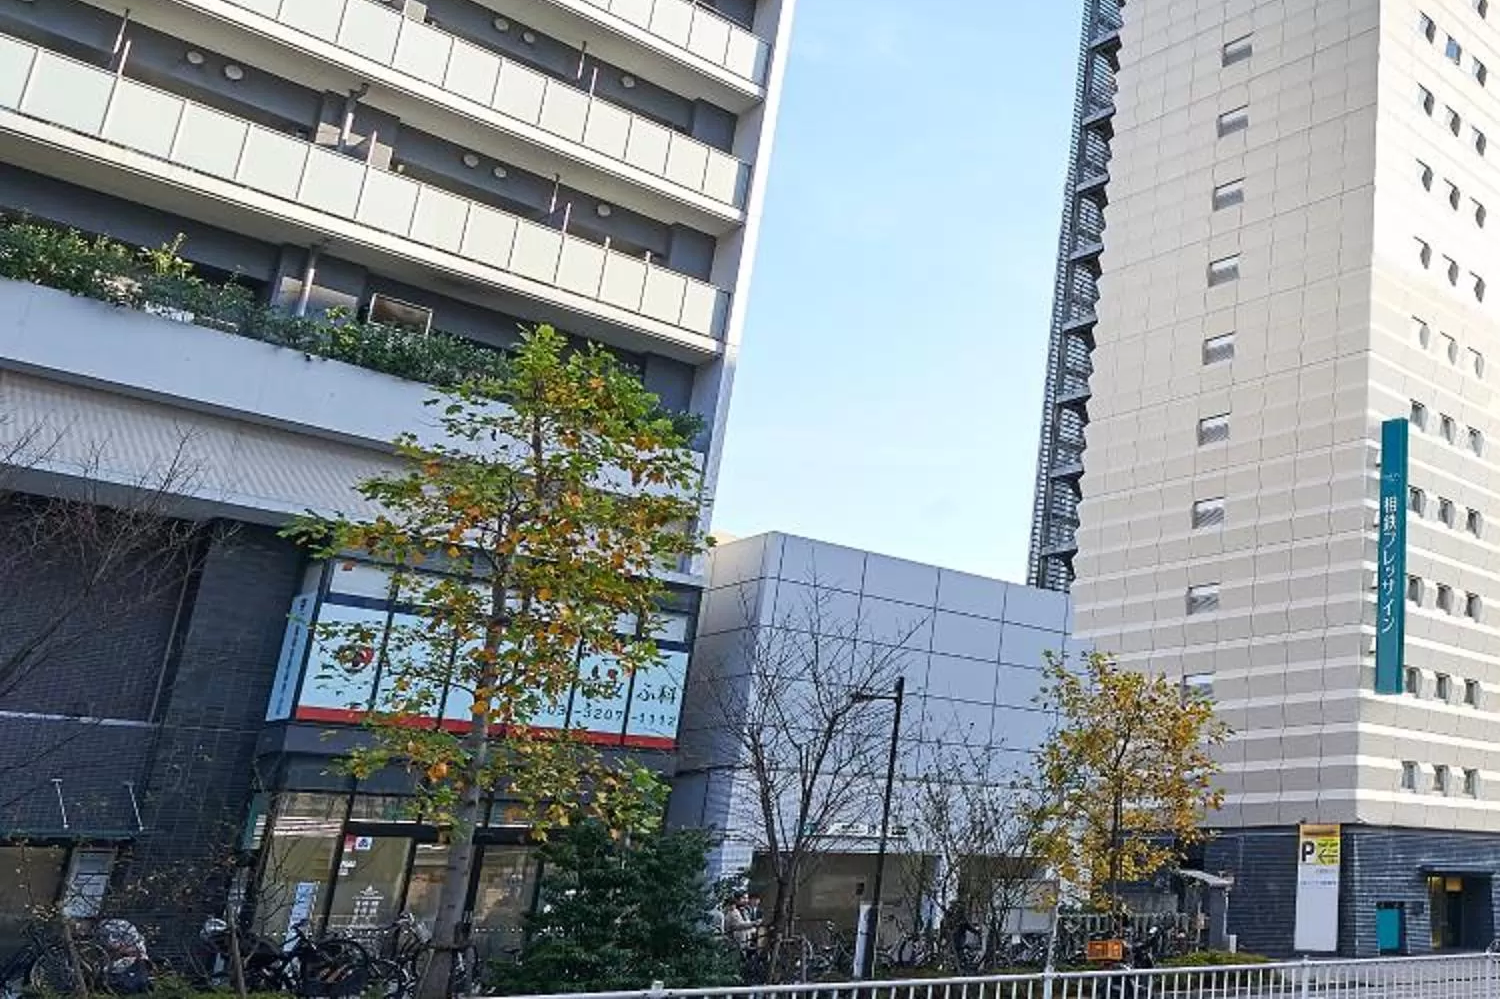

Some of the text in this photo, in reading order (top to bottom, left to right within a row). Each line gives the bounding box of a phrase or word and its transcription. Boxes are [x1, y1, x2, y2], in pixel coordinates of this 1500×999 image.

[1382, 496, 1397, 633] 相鉄フレッサイン
[1302, 840, 1315, 862] P
